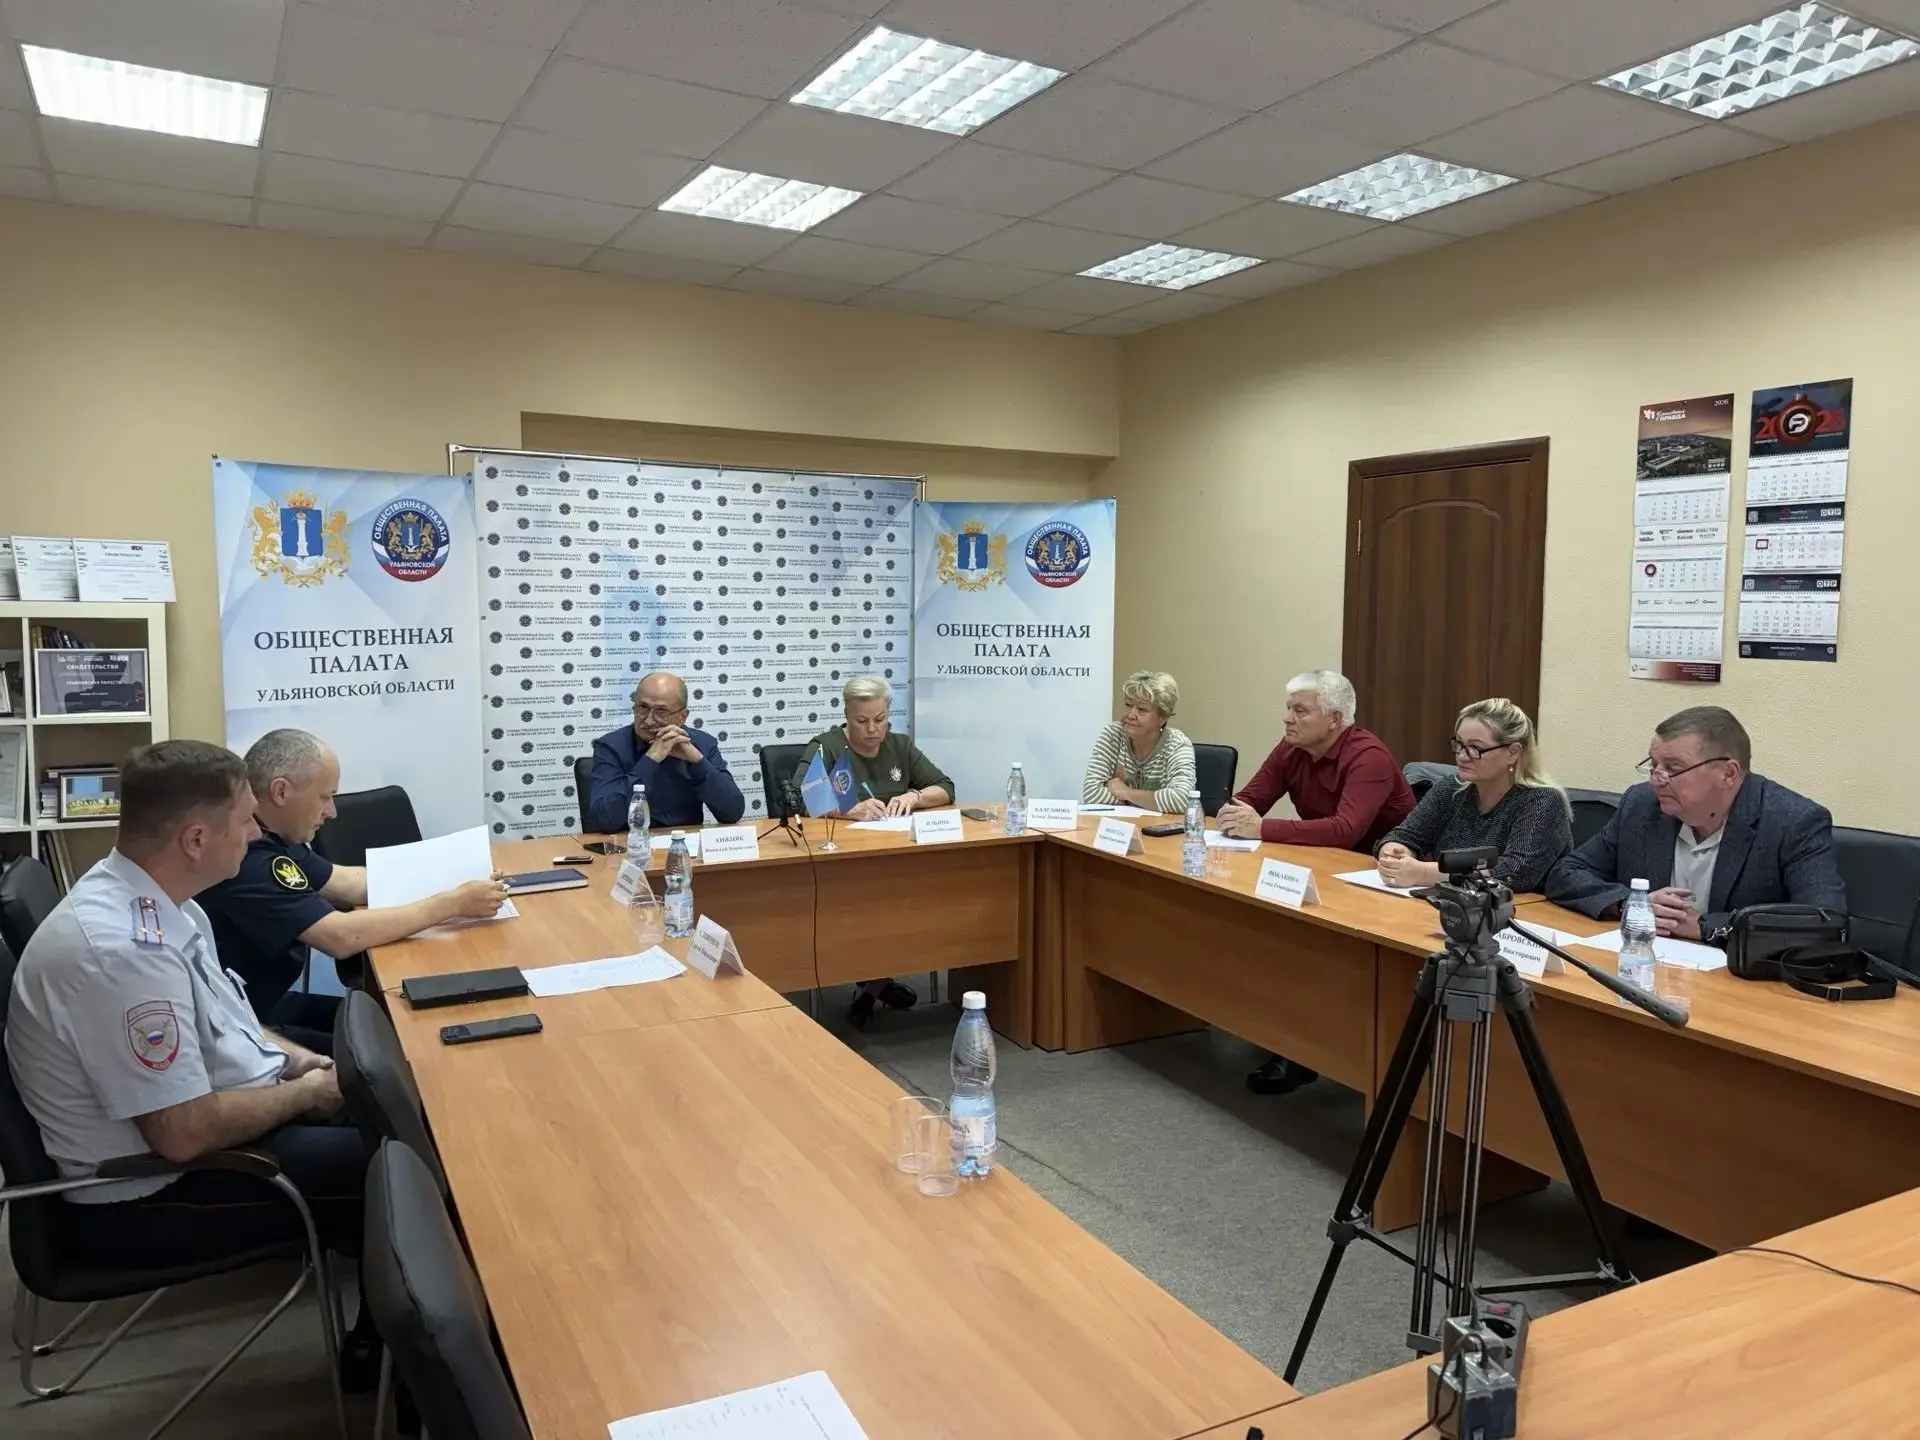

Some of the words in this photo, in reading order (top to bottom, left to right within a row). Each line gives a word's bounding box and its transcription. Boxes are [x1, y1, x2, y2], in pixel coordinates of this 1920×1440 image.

[374, 501, 427, 540] ОБЩЕСТВЕННАЯ
[427, 509, 448, 542] ПАЛАТА
[254, 627, 454, 652] ОБЩЕСТВЕННАЯ
[936, 623, 1091, 640] ОБЩЕСТВЕННАЯ
[974, 643, 1051, 658] ПАЛАТА
[309, 653, 409, 674] ПАЛАТА
[937, 665, 1028, 676] УЛЬЯНОВСКОЙ
[1031, 667, 1090, 677] ОБЛАСТИ
[256, 681, 381, 702] УЛЬЯНОВСКОЙ
[385, 679, 455, 694] ОБЛАСТИ
[1496, 931, 1544, 949] АБРОВСК
[1503, 946, 1541, 962] Викторович
